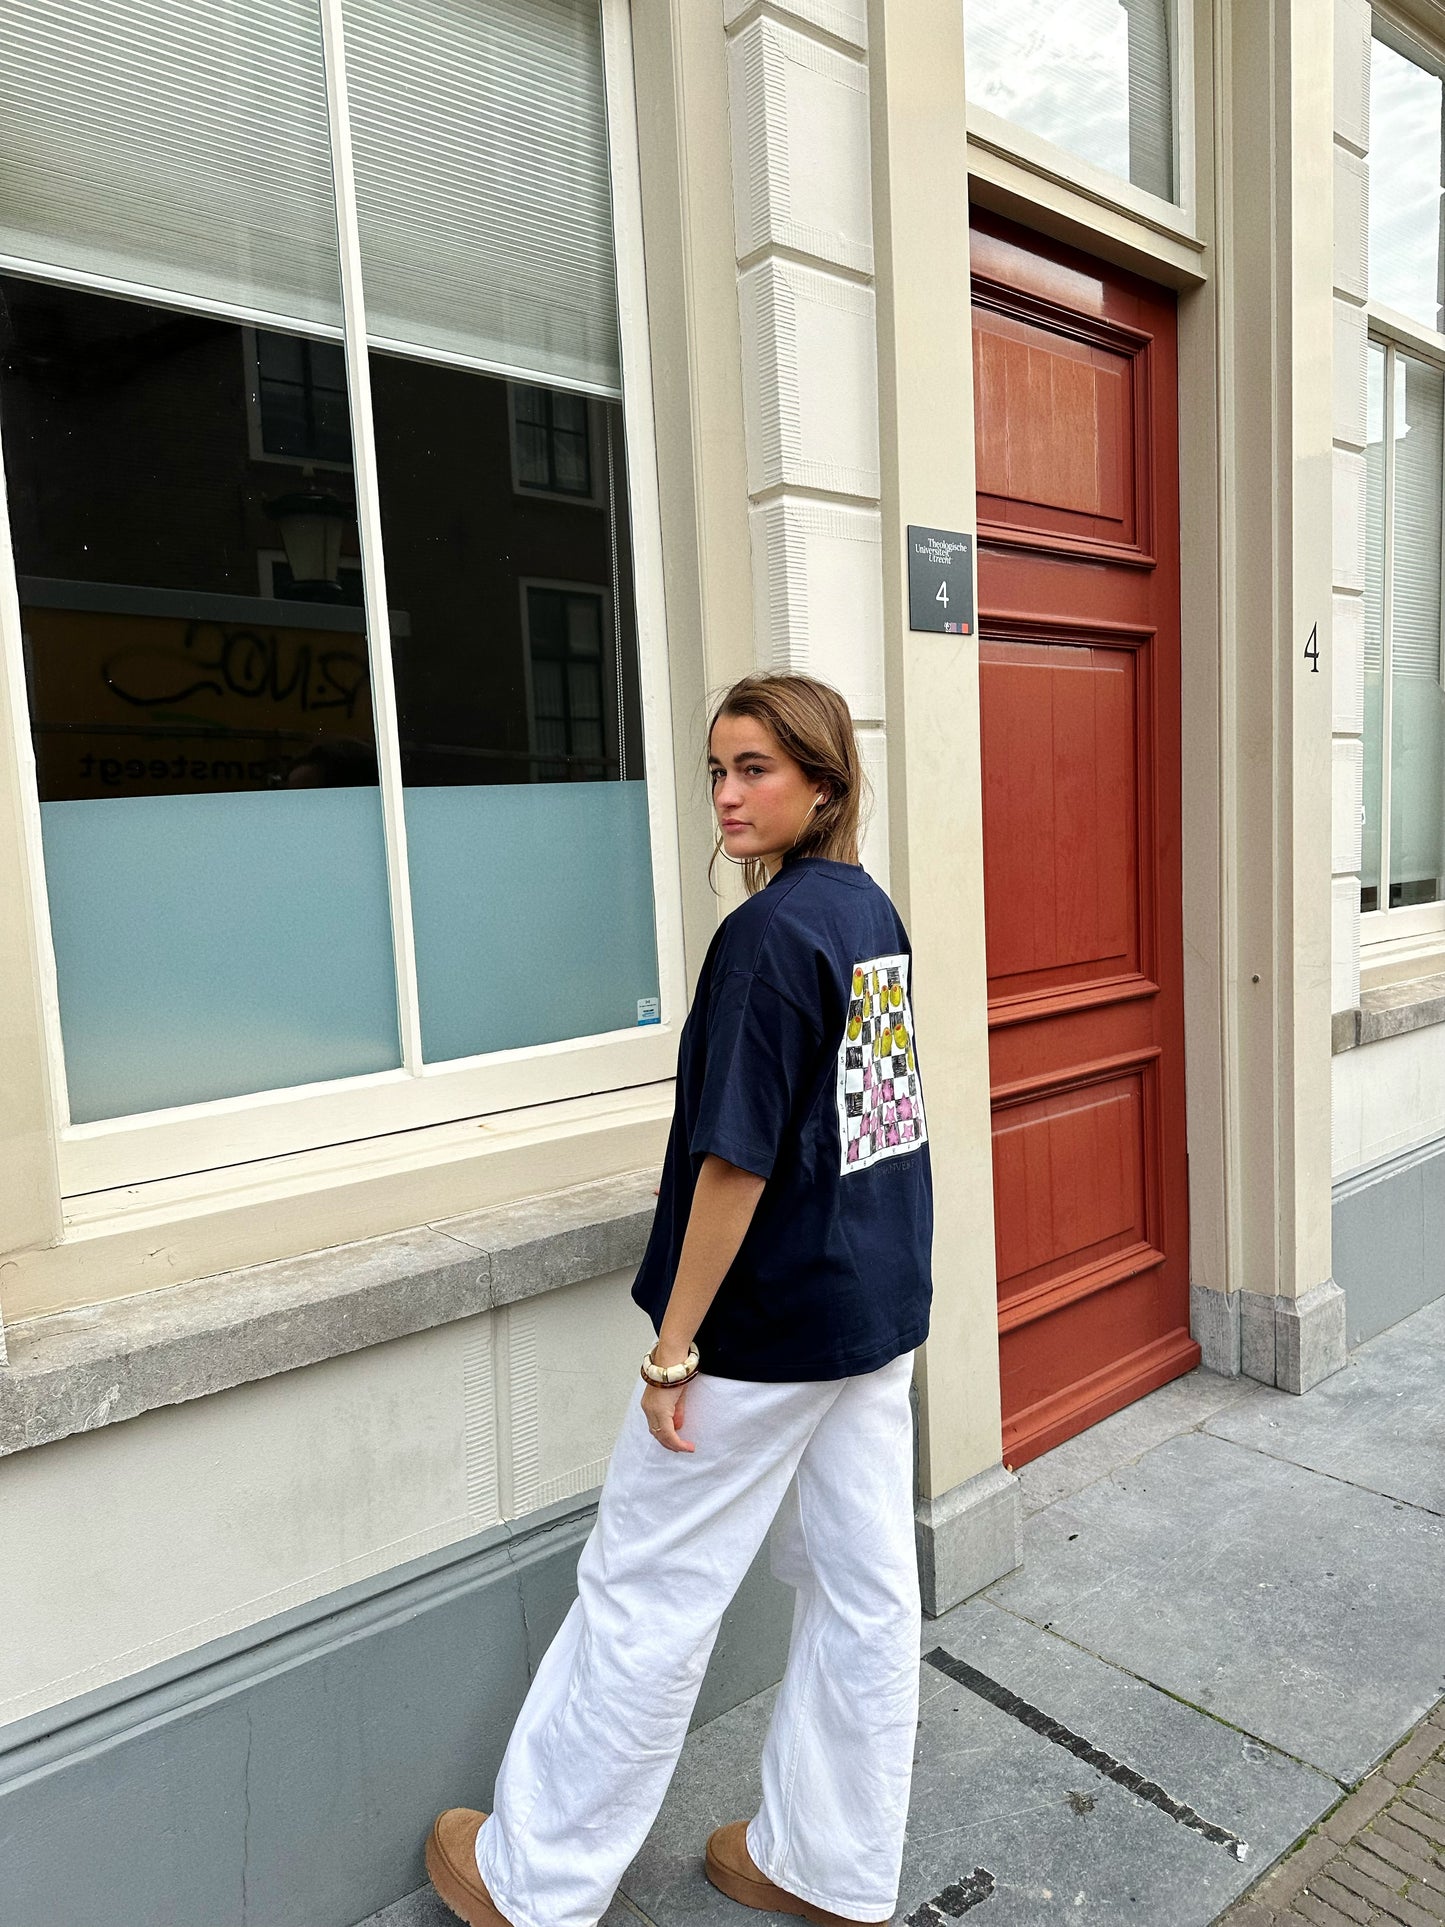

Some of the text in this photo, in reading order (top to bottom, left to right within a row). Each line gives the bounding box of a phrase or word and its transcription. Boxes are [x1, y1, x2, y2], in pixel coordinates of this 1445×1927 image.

[915, 543, 951, 557] Universiteit
[927, 537, 968, 553] Theologische
[928, 554, 952, 565] Utrecht
[935, 580, 950, 609] 4
[1304, 621, 1320, 673] 4
